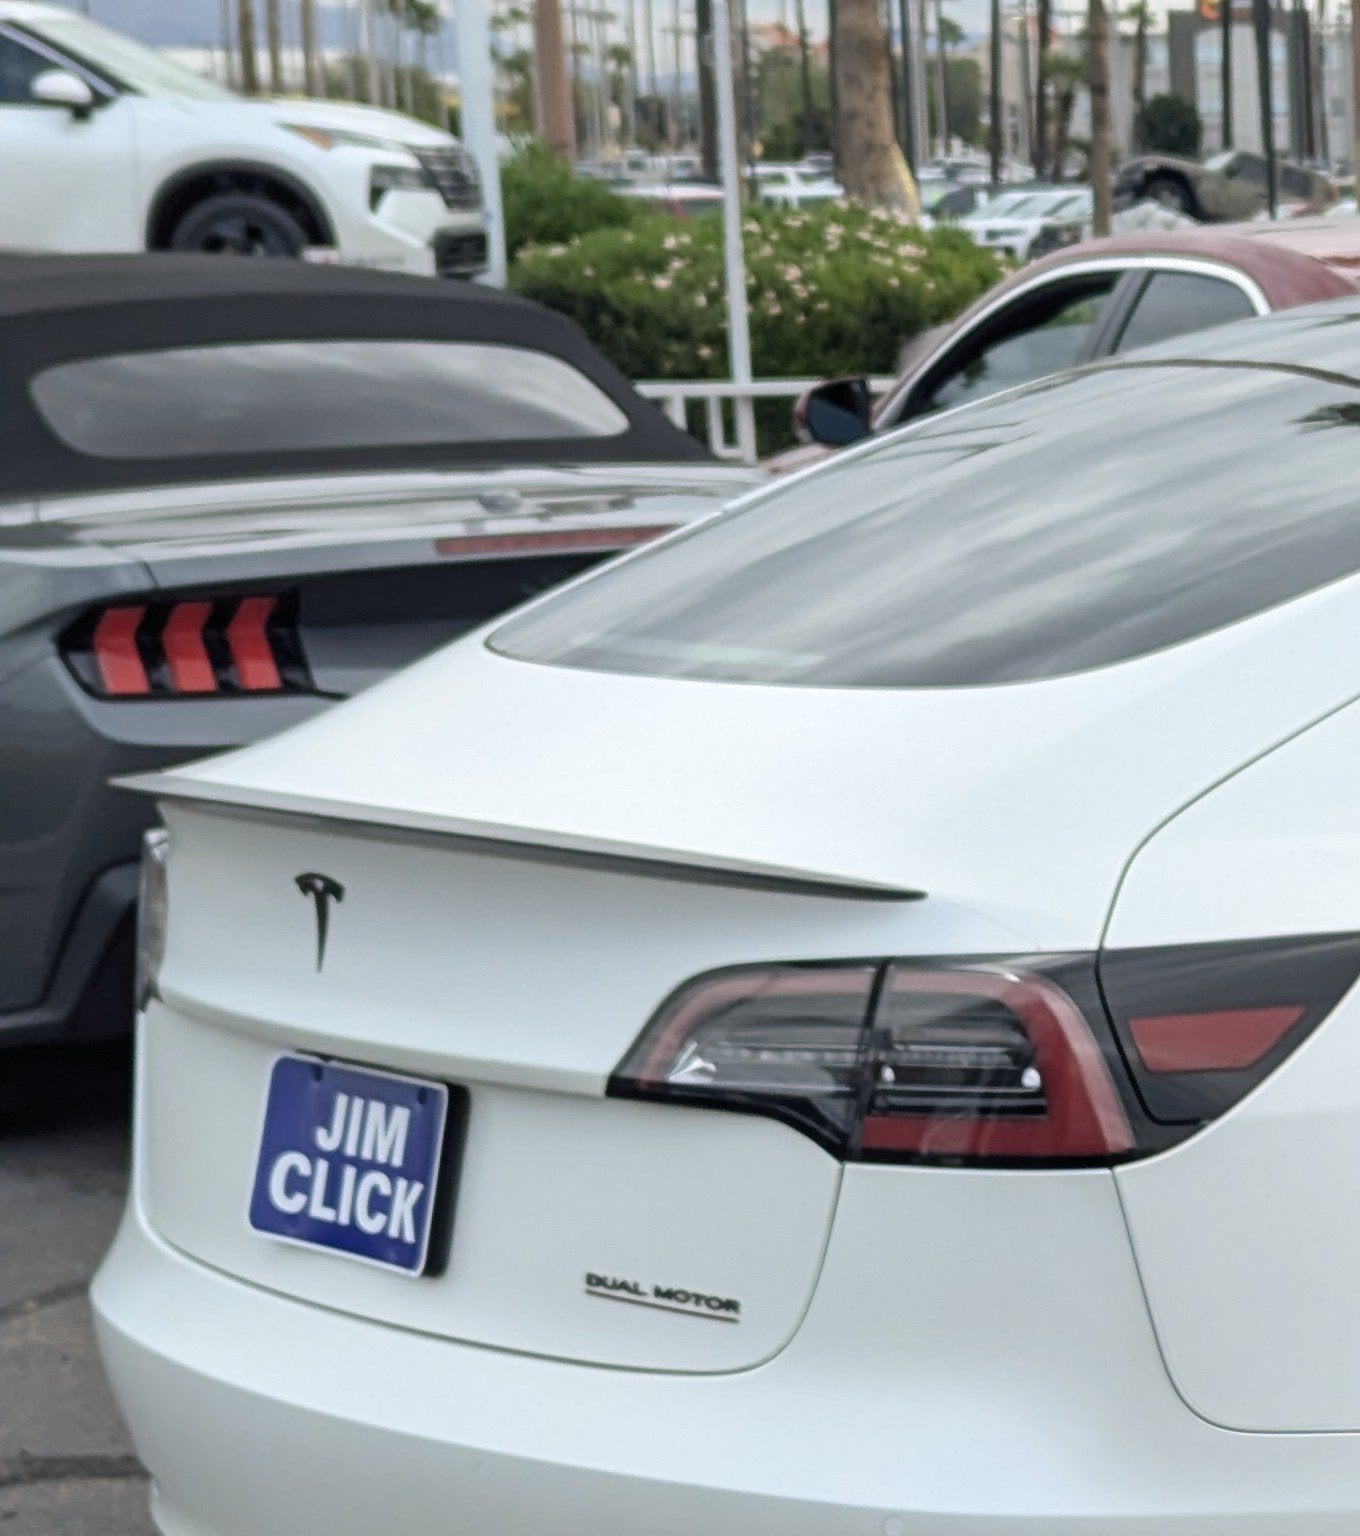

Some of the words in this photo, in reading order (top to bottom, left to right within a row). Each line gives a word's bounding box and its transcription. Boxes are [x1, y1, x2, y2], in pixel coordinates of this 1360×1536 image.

[315, 1092, 411, 1168] JIM
[269, 1150, 425, 1244] CLICK
[585, 1271, 648, 1297] DUAL
[652, 1283, 741, 1314] MOTOR
